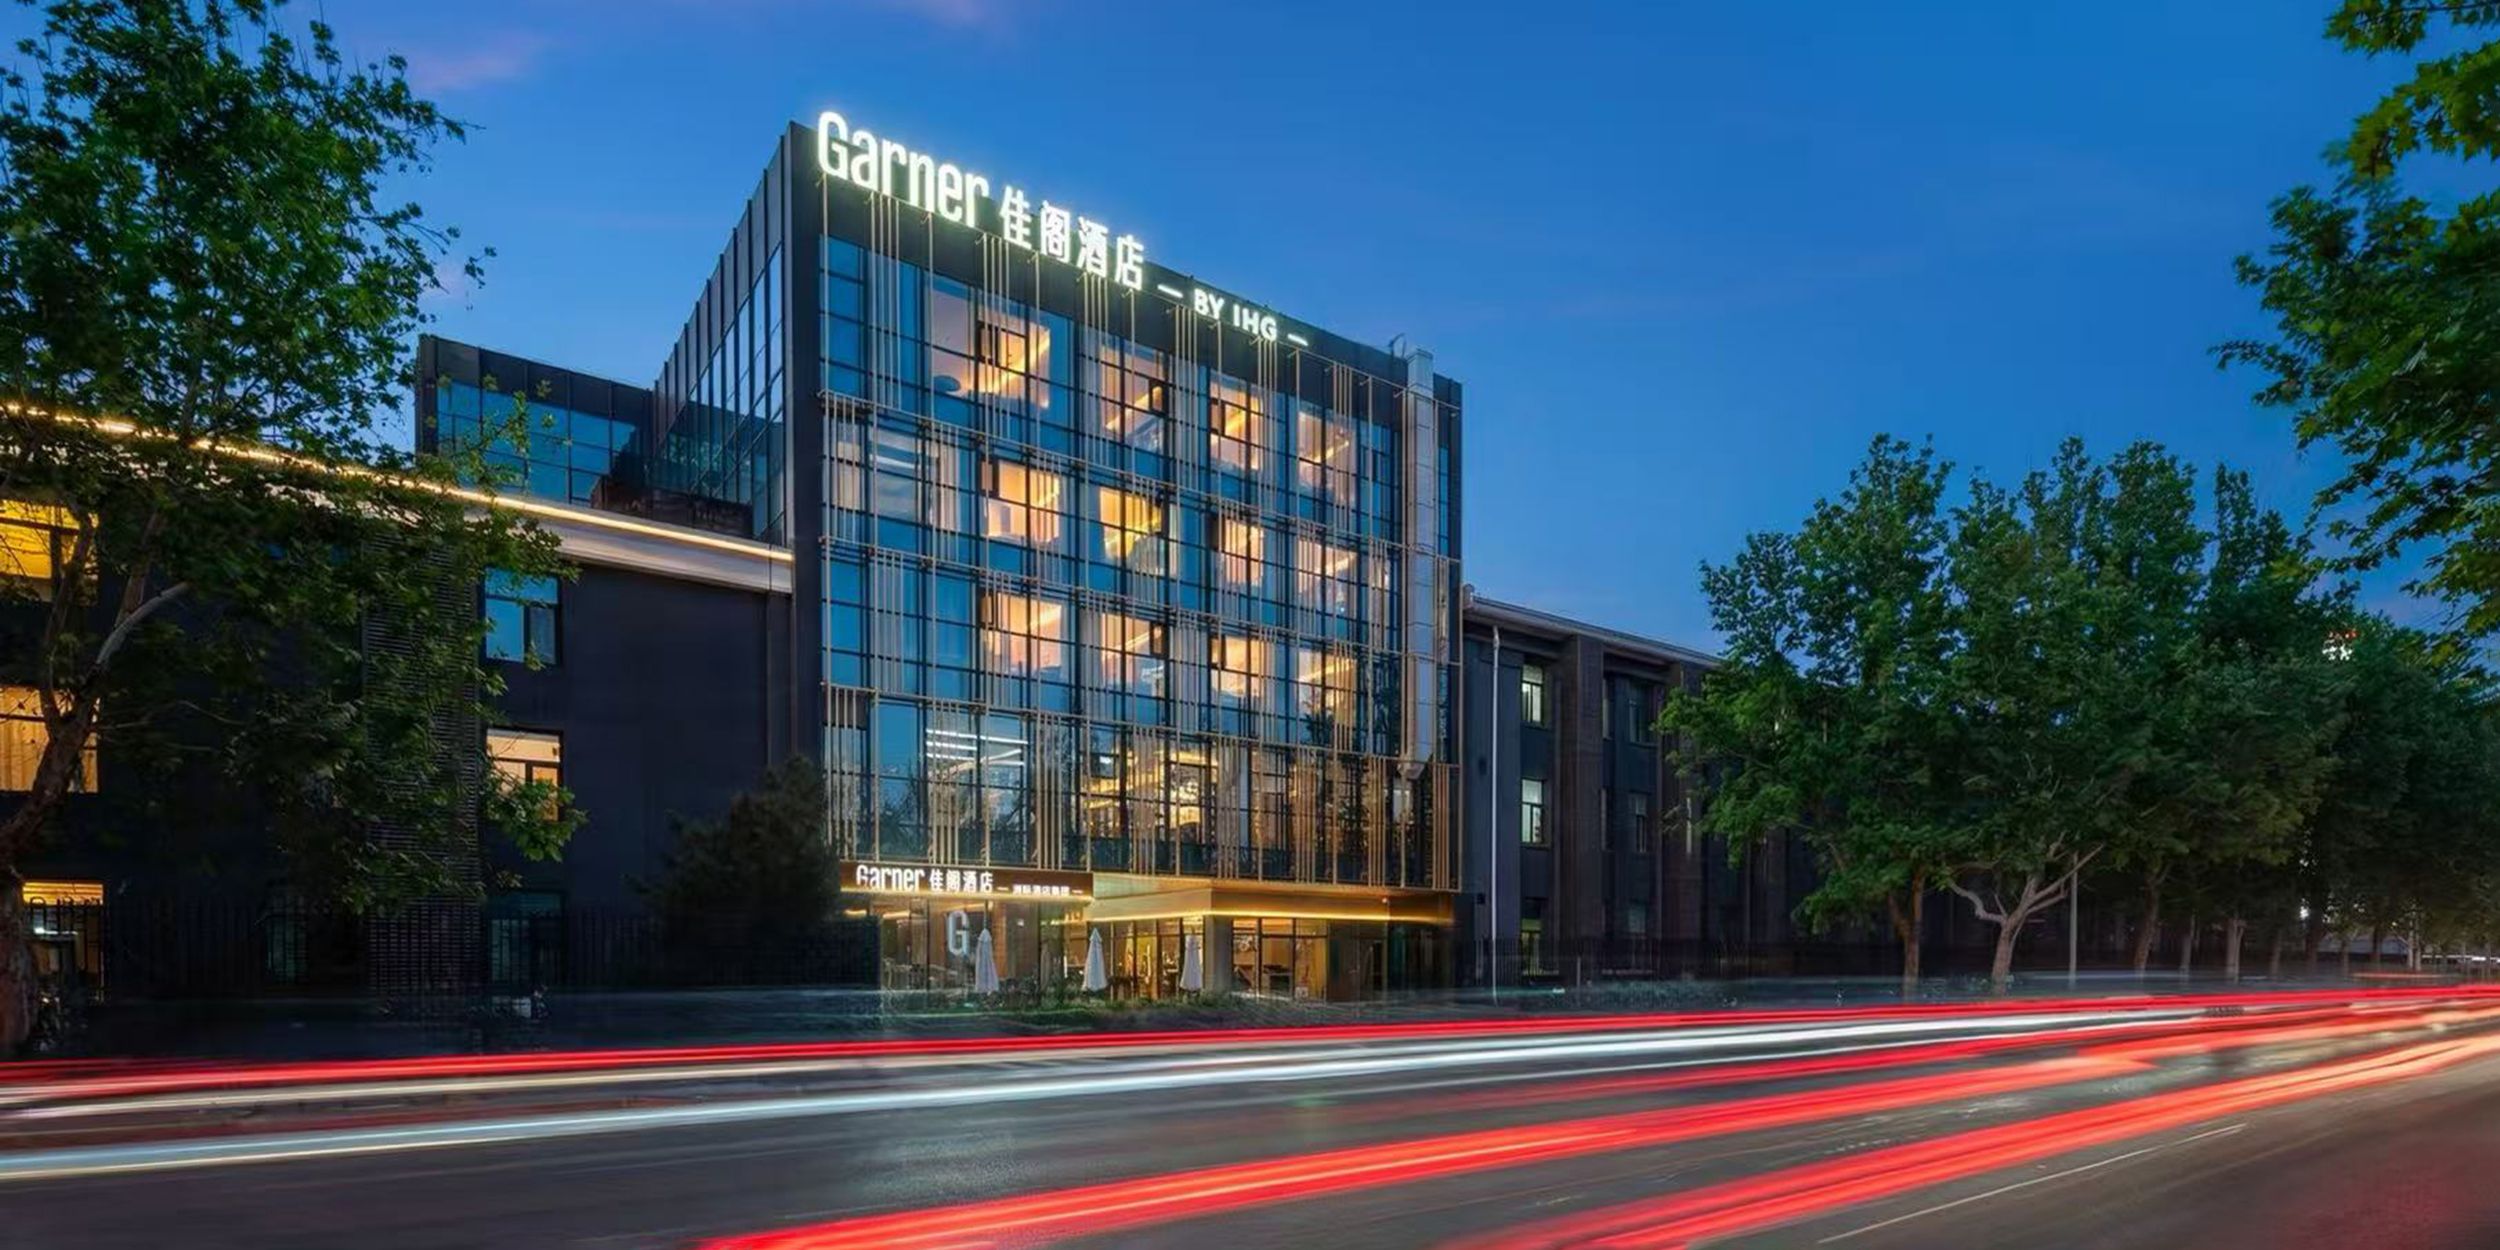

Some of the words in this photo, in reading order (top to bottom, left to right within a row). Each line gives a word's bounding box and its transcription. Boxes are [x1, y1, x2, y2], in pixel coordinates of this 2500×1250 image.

[817, 111, 989, 228] Garner
[1000, 186, 1144, 291] 佳阁酒店
[1194, 288, 1225, 320] BY
[1233, 303, 1277, 341] IHG
[856, 864, 925, 892] Garner
[929, 868, 994, 893] 佳阁酒店
[947, 910, 970, 957] G
